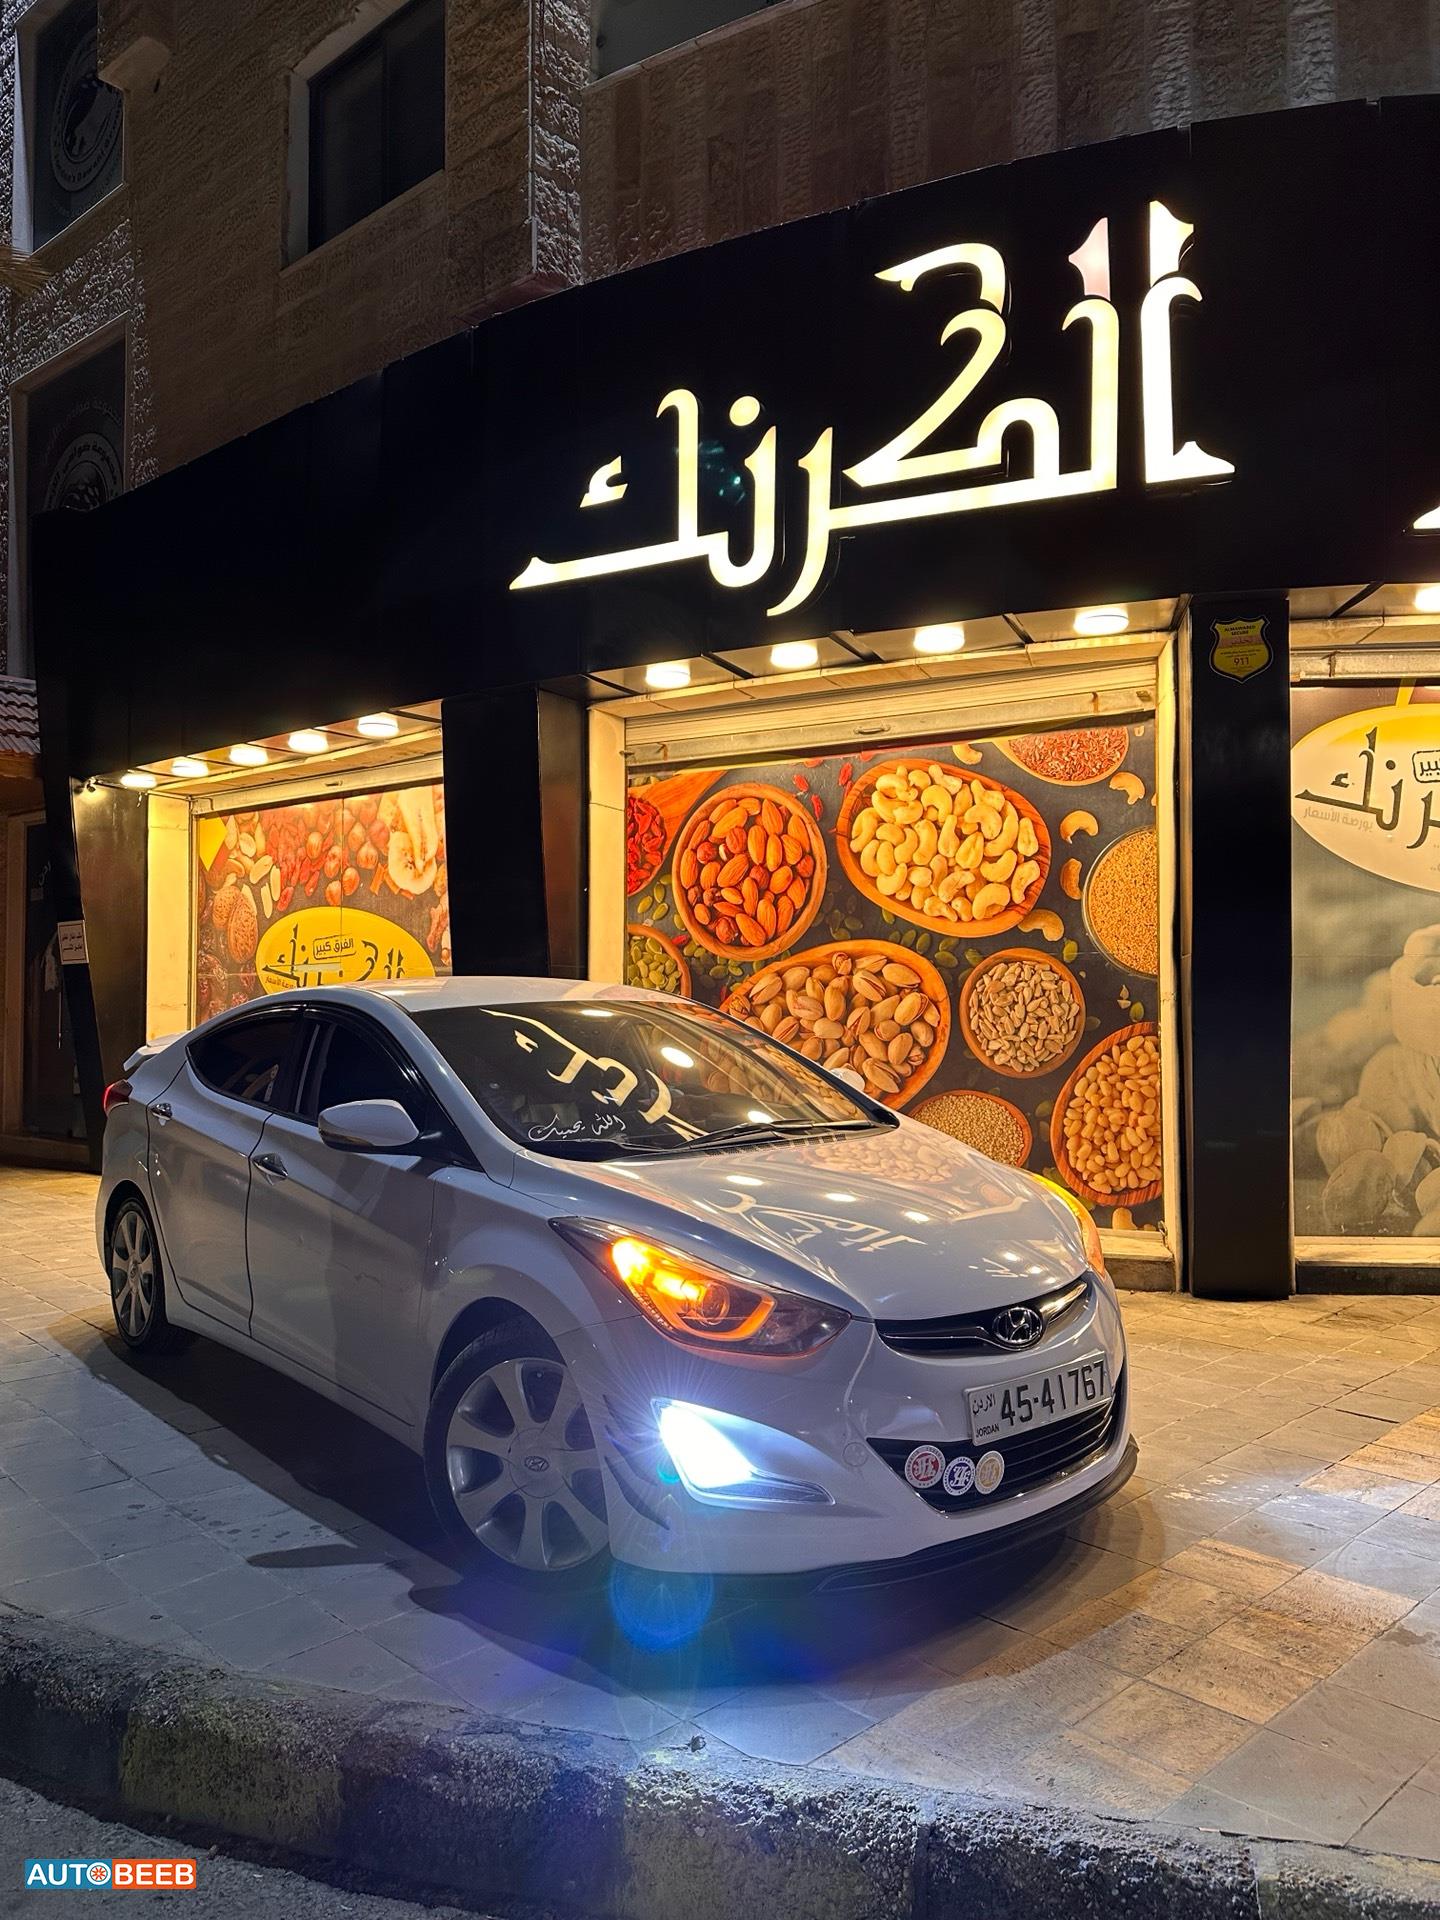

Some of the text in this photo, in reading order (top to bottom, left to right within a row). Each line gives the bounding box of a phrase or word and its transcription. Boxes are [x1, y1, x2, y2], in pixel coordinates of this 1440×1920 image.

[1234, 656, 1249, 666] 911
[316, 938, 354, 956] الفرق كبير
[1000, 1358, 1105, 1427] 45-41767
[976, 1423, 1000, 1438] JORDAN
